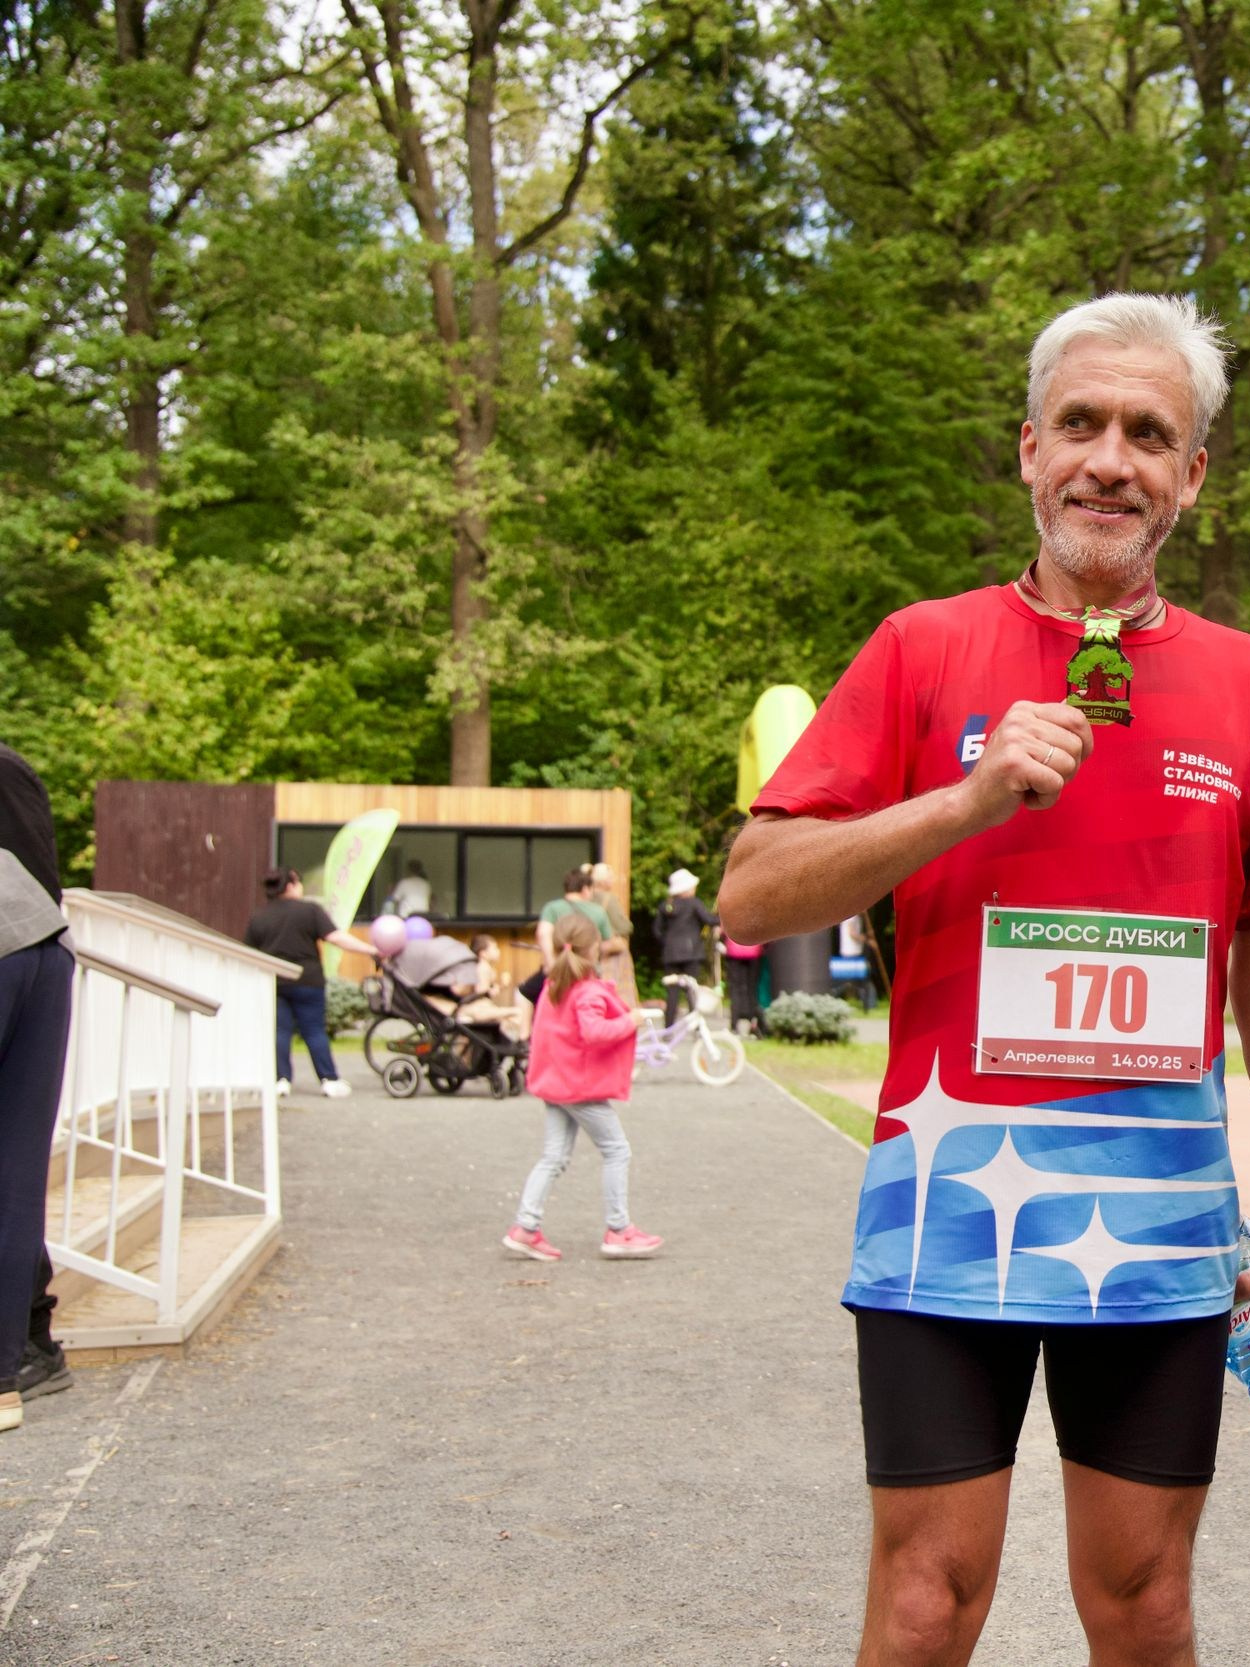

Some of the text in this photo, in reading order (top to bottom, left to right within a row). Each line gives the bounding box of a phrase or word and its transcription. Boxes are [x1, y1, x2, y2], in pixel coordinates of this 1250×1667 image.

[1083, 707, 1123, 719] УБКИ
[1163, 749, 1232, 777] И ЗВЁЗДЫ
[1163, 783, 1218, 804] БЛИЖЕ
[1010, 922, 1186, 949] КРОСС ДУБКИ
[1045, 963, 1148, 1034] 170
[1003, 1049, 1182, 1070] Апрелевка 14.09.25
